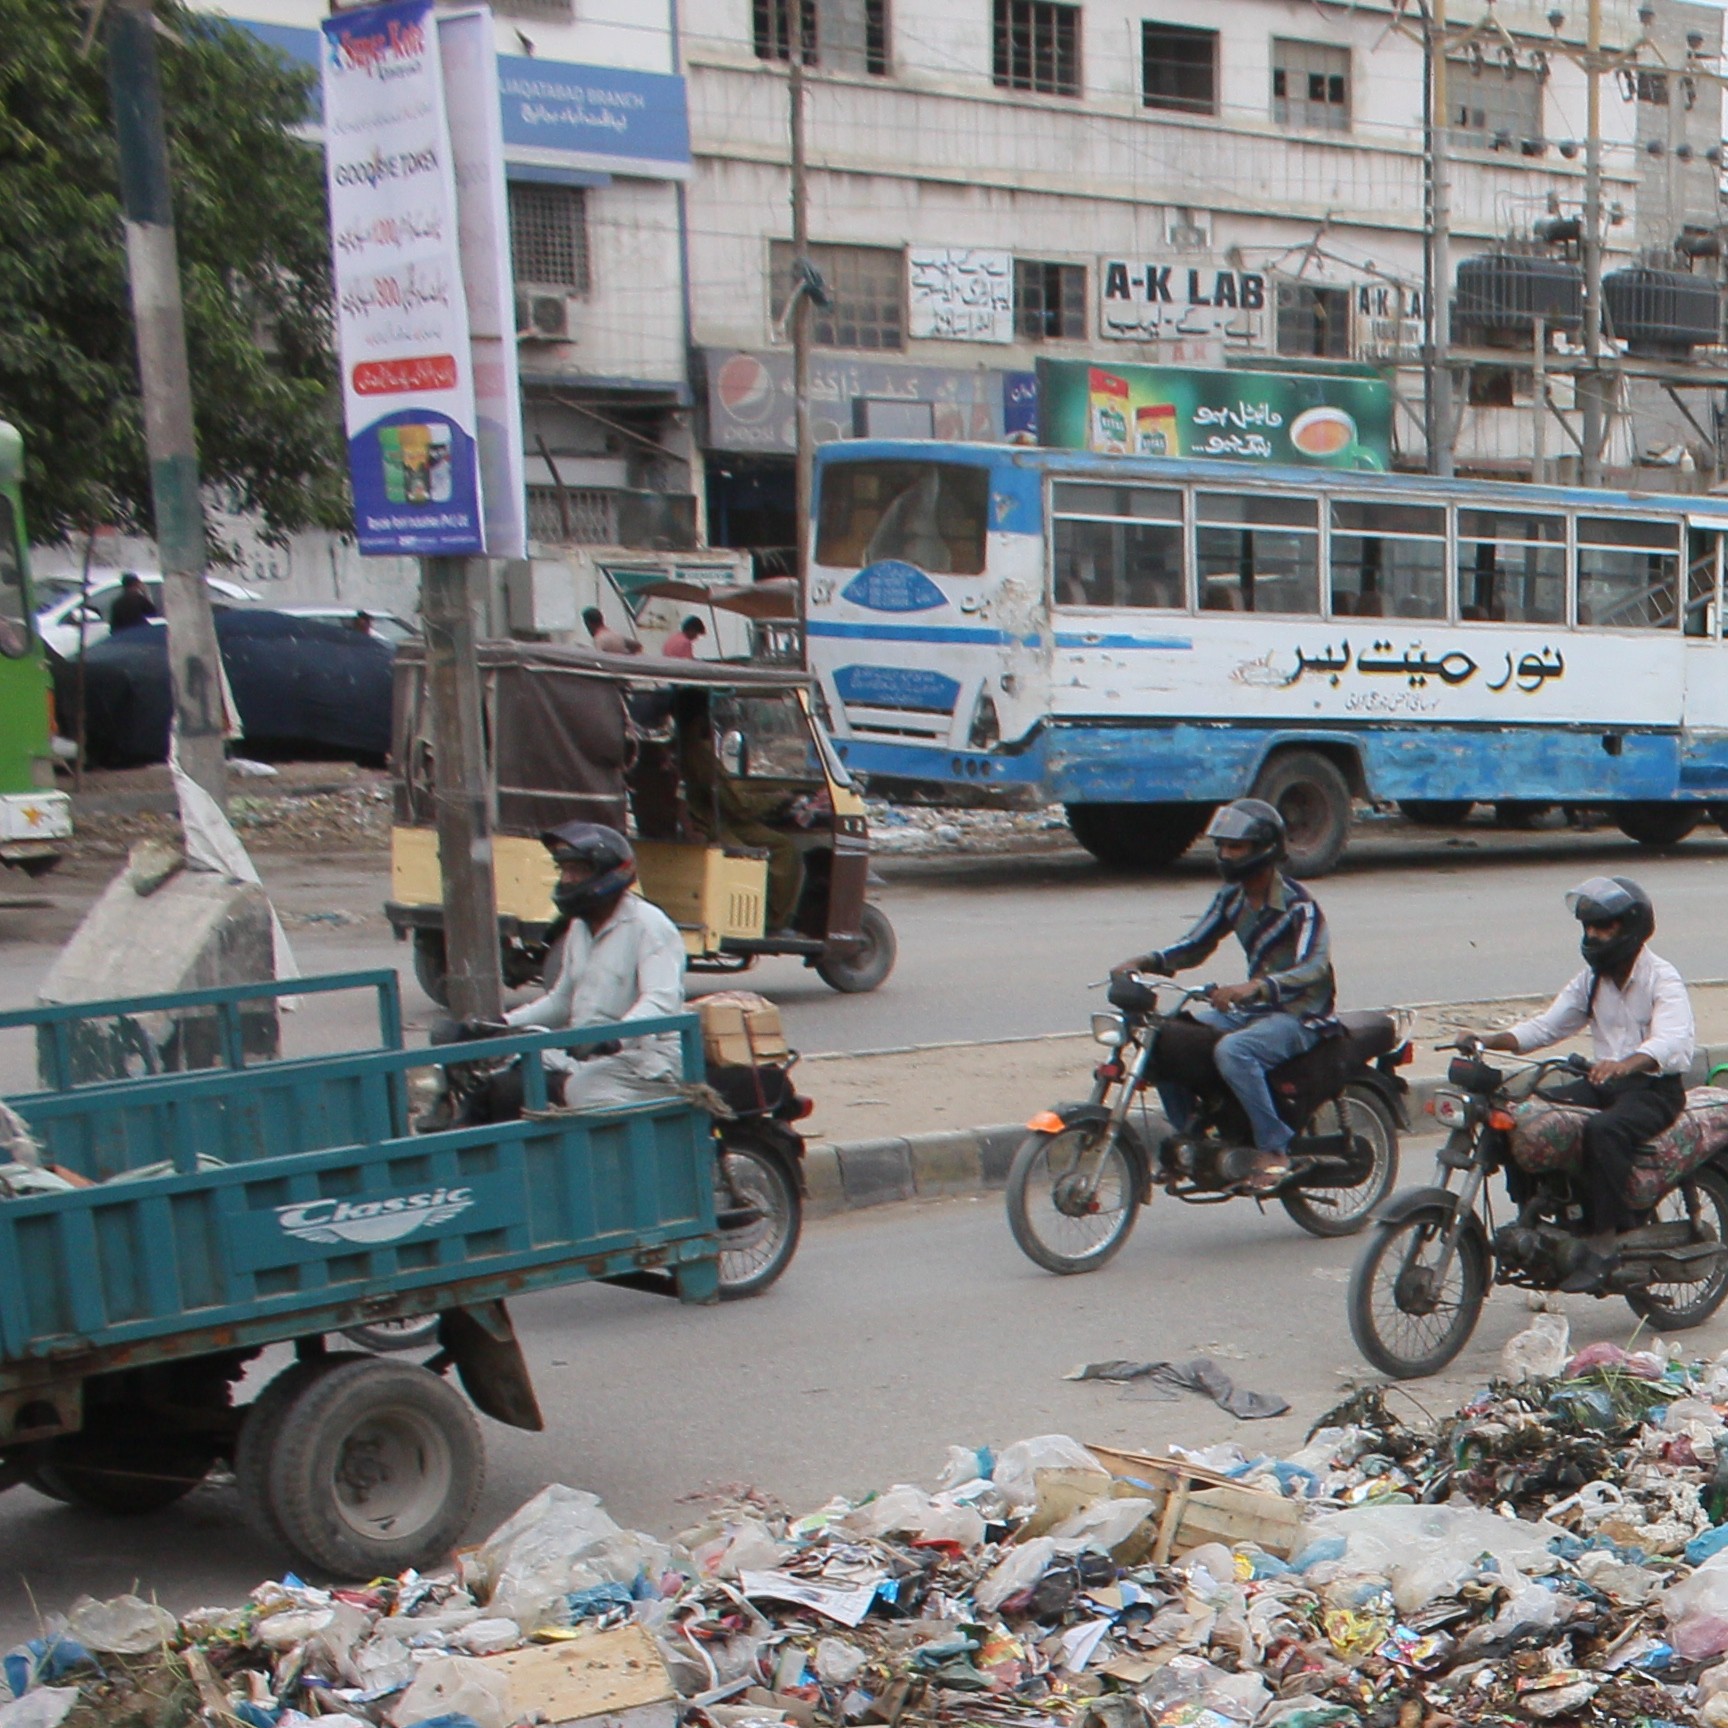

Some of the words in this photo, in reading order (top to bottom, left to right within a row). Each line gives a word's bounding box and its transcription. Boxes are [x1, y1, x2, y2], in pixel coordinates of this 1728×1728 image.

[586, 87, 646, 110] BRANCH
[1105, 262, 1172, 304] A-K
[1188, 267, 1265, 312] LAB
[274, 1187, 473, 1229] Classic
